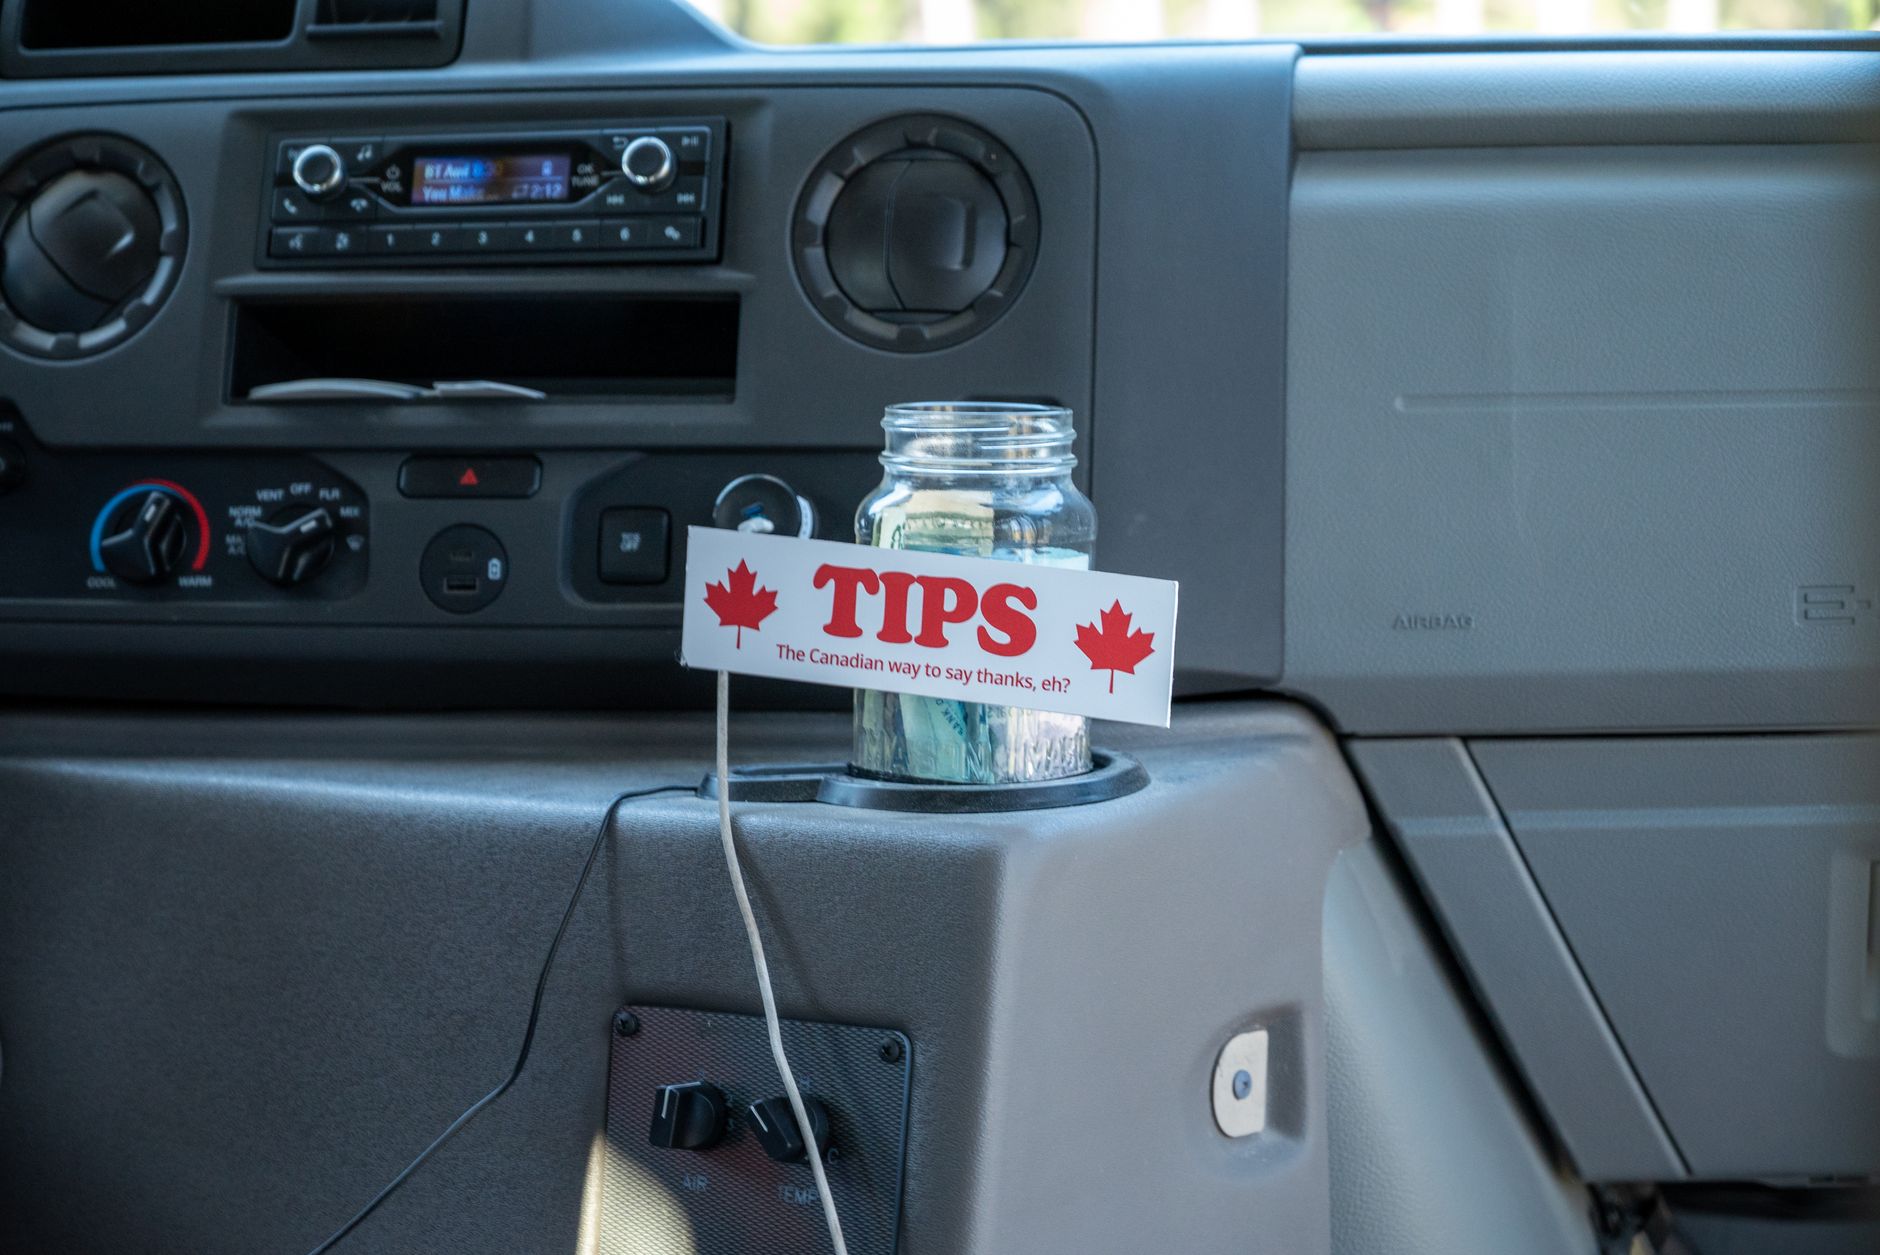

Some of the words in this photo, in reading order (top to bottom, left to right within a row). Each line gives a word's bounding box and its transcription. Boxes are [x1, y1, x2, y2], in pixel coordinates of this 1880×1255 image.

[256, 488, 285, 502] VENT
[289, 482, 312, 496] OFF
[228, 505, 262, 518] NORM
[225, 533, 243, 544] MA
[178, 575, 213, 587] WARM
[813, 563, 1038, 657] TIPS
[1392, 614, 1475, 630] AIRBAG
[776, 643, 806, 662] The
[809, 648, 884, 671] Canadian
[888, 659, 922, 680] way
[925, 662, 942, 678] to
[945, 667, 973, 686] say
[976, 667, 1037, 692] thanks,
[1041, 676, 1071, 694] eh?
[681, 1174, 709, 1191] AIR
